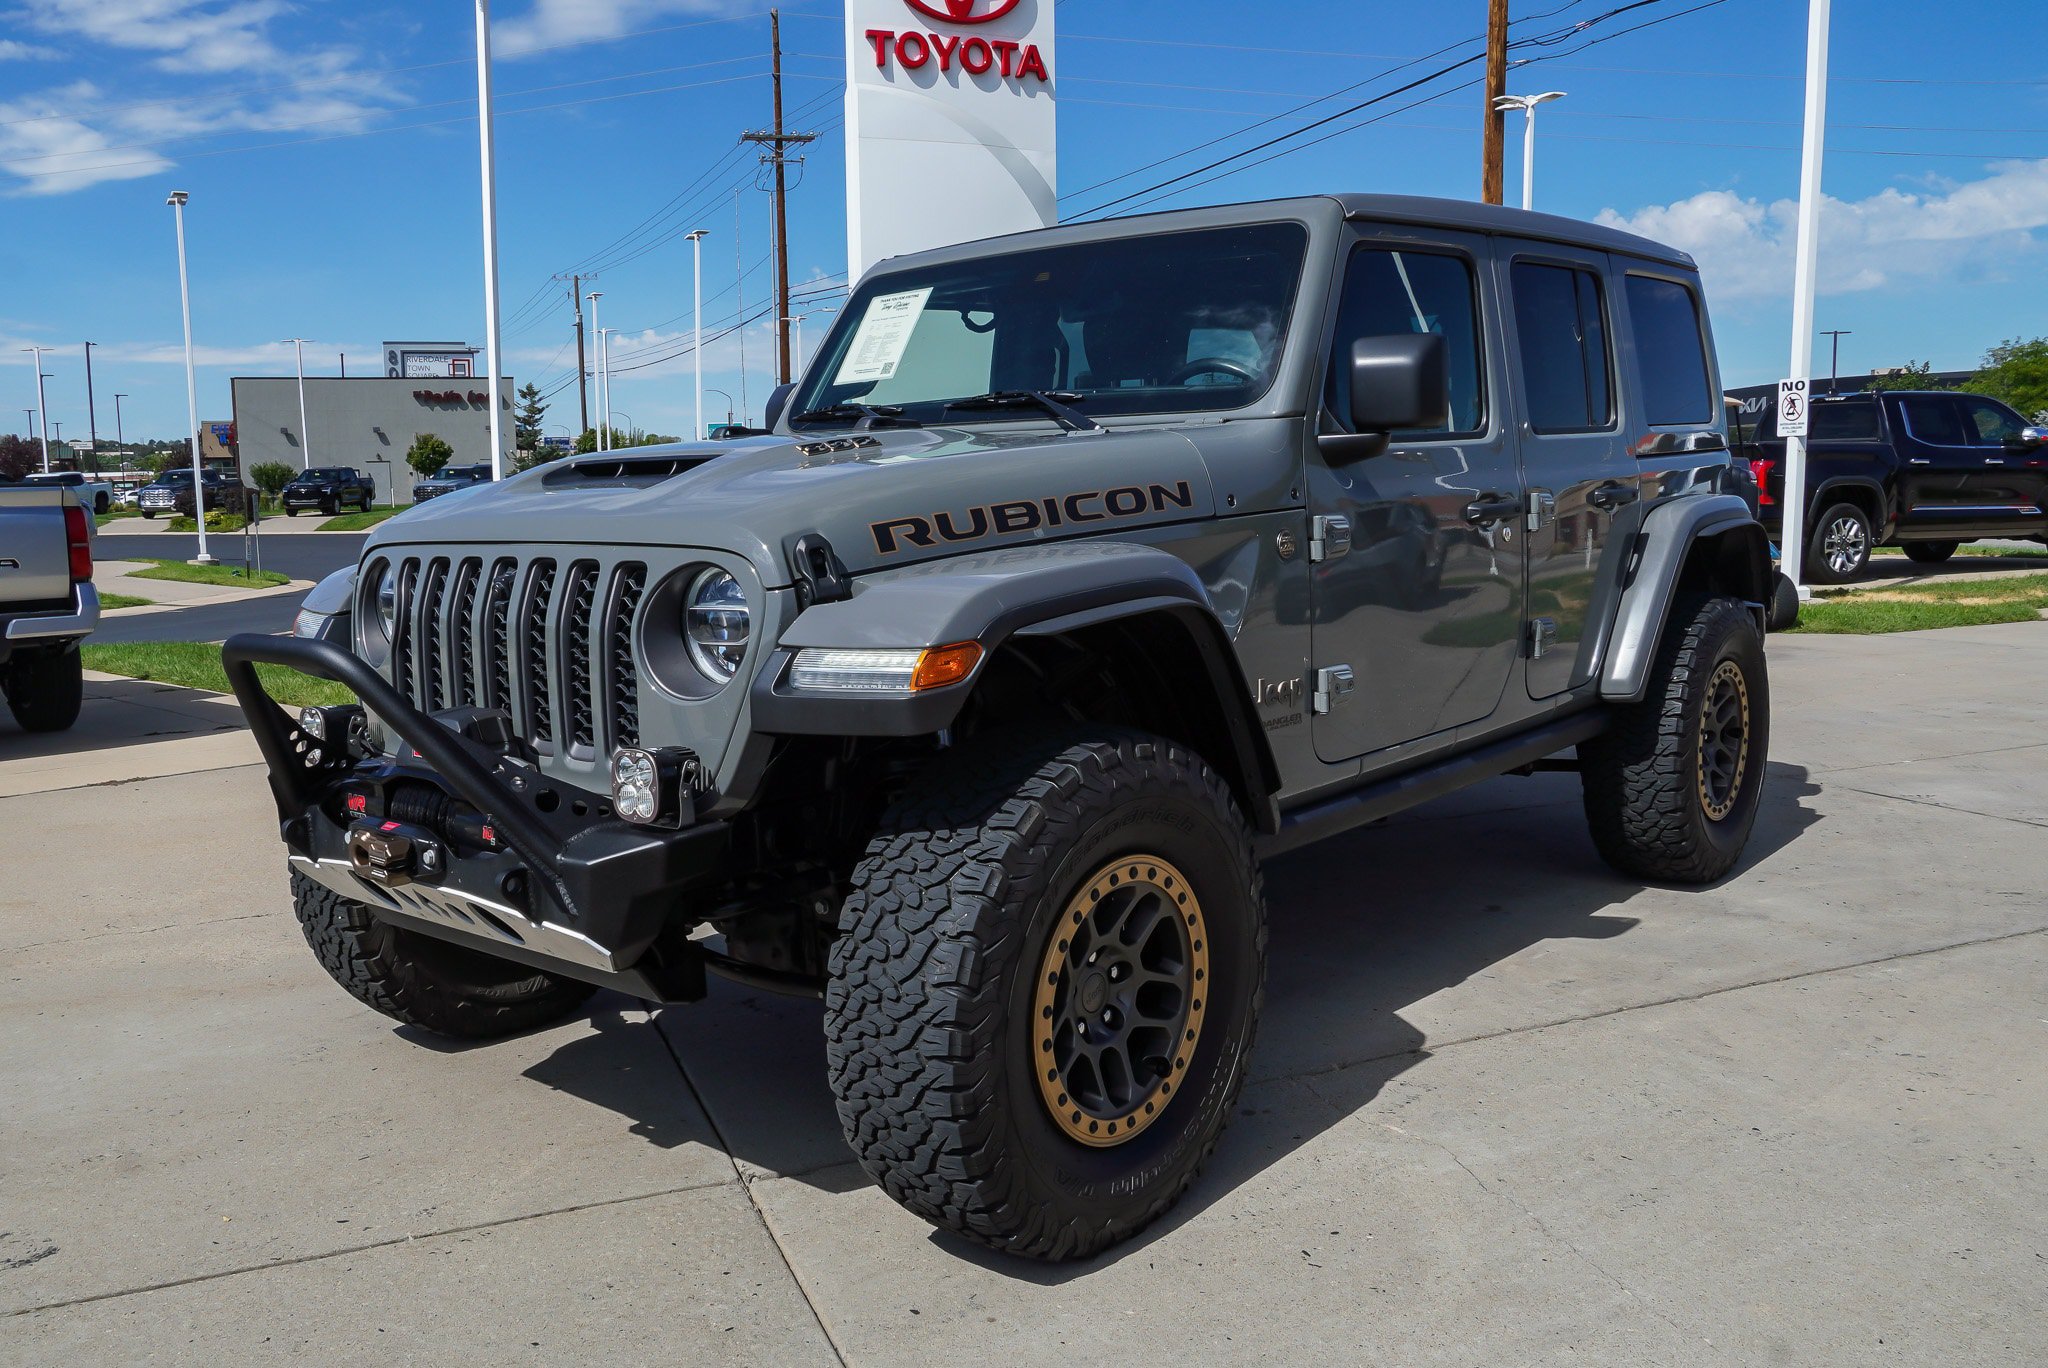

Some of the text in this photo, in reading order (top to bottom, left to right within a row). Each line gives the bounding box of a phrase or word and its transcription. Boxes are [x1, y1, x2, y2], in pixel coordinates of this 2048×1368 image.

[865, 29, 1048, 82] TOYOTA
[406, 355, 449, 363] RIVERDALE
[407, 364, 431, 372] TOWN
[1782, 380, 1805, 392] NO
[869, 480, 1194, 556] RUBICON
[1254, 678, 1303, 709] Jeep
